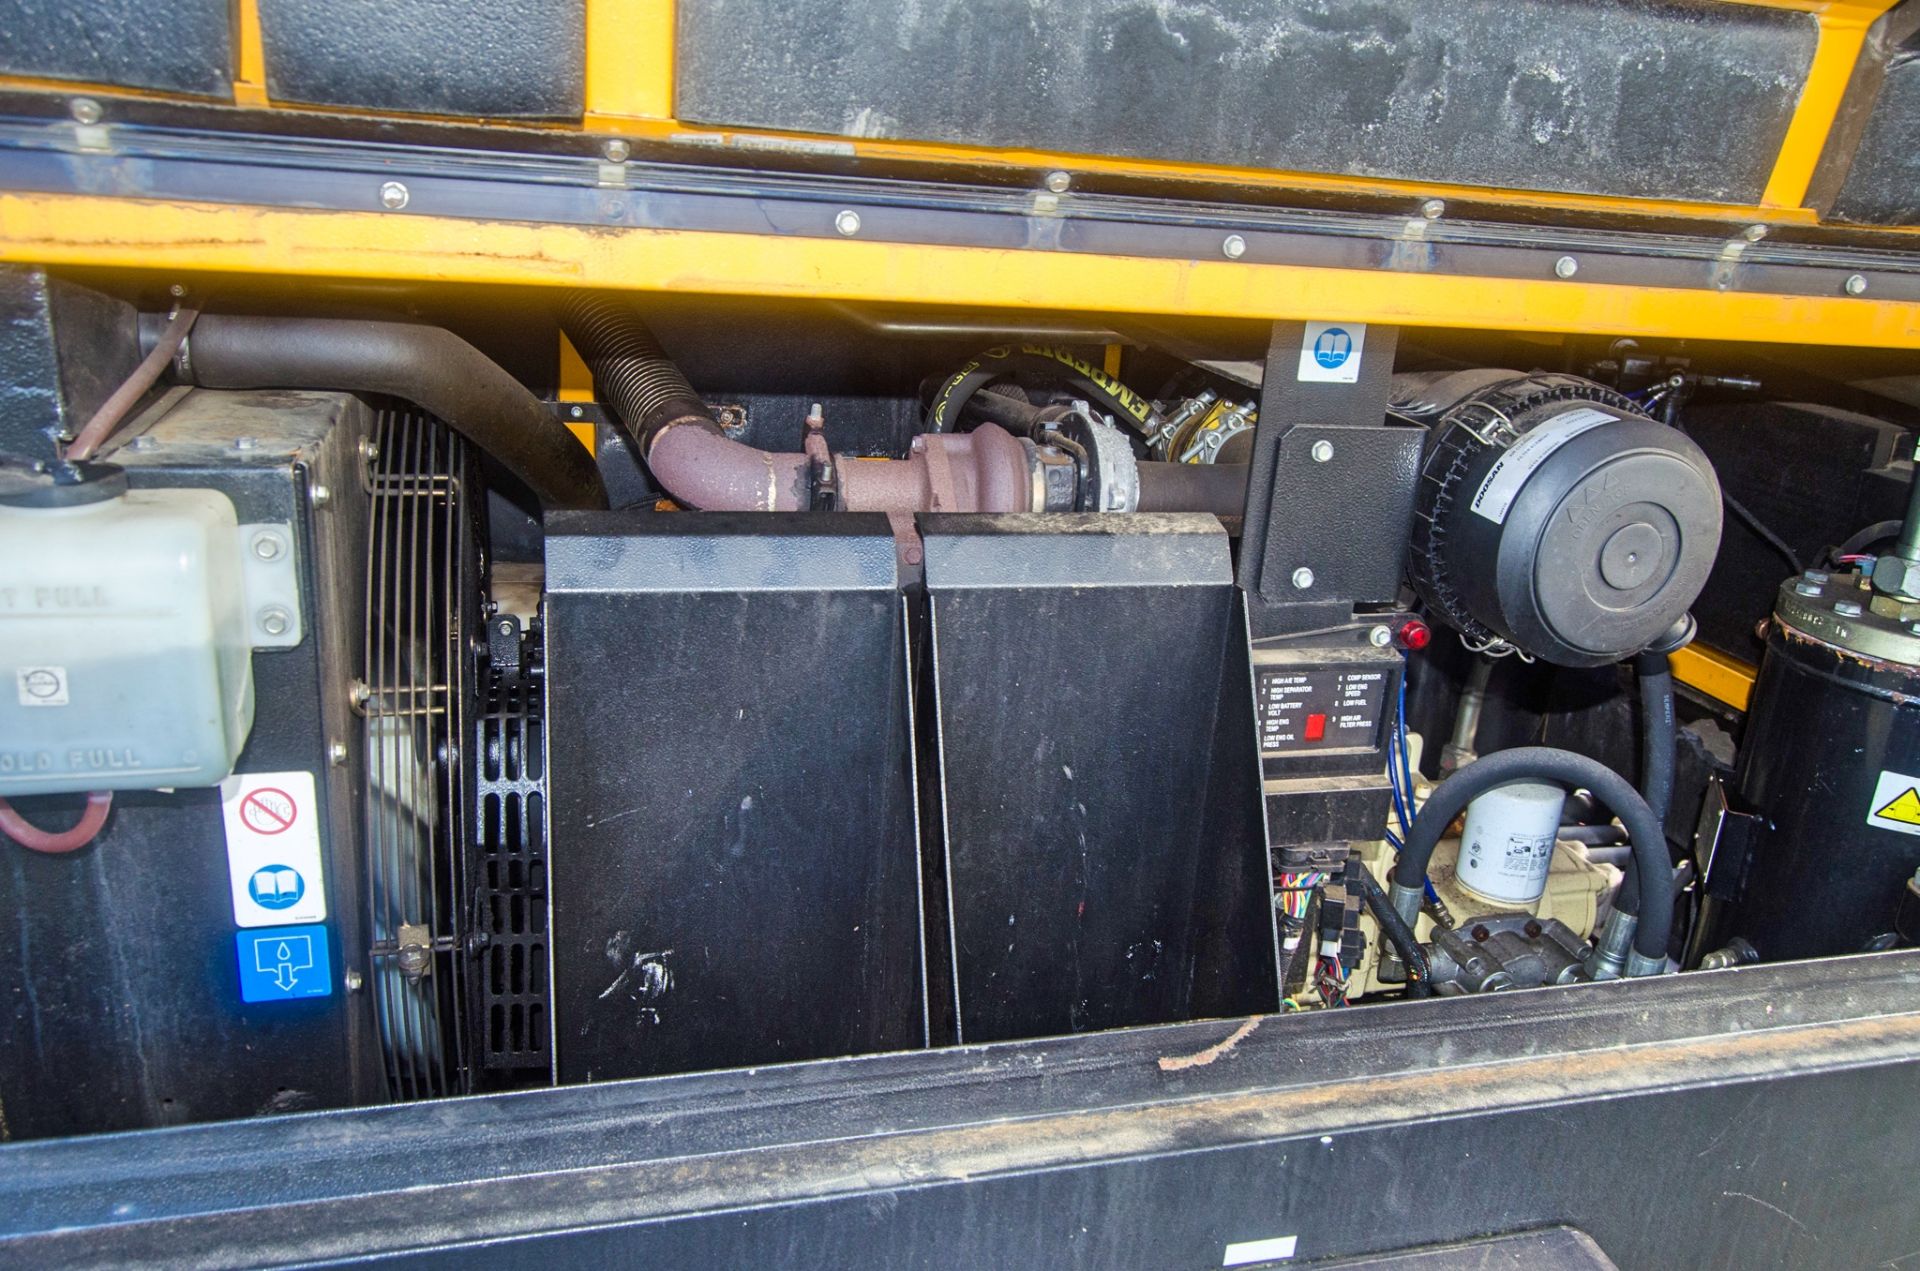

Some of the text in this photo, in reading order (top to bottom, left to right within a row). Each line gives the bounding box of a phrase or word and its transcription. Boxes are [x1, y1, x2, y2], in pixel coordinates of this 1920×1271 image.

[1475, 461, 1505, 508] DOOSAN
[34, 585, 109, 608] FULL
[1271, 677, 1284, 685] HIGH
[1361, 673, 1381, 681] SENSOR
[1283, 685, 1312, 694] SEPARATOR
[0, 749, 142, 772] OLD FULL
